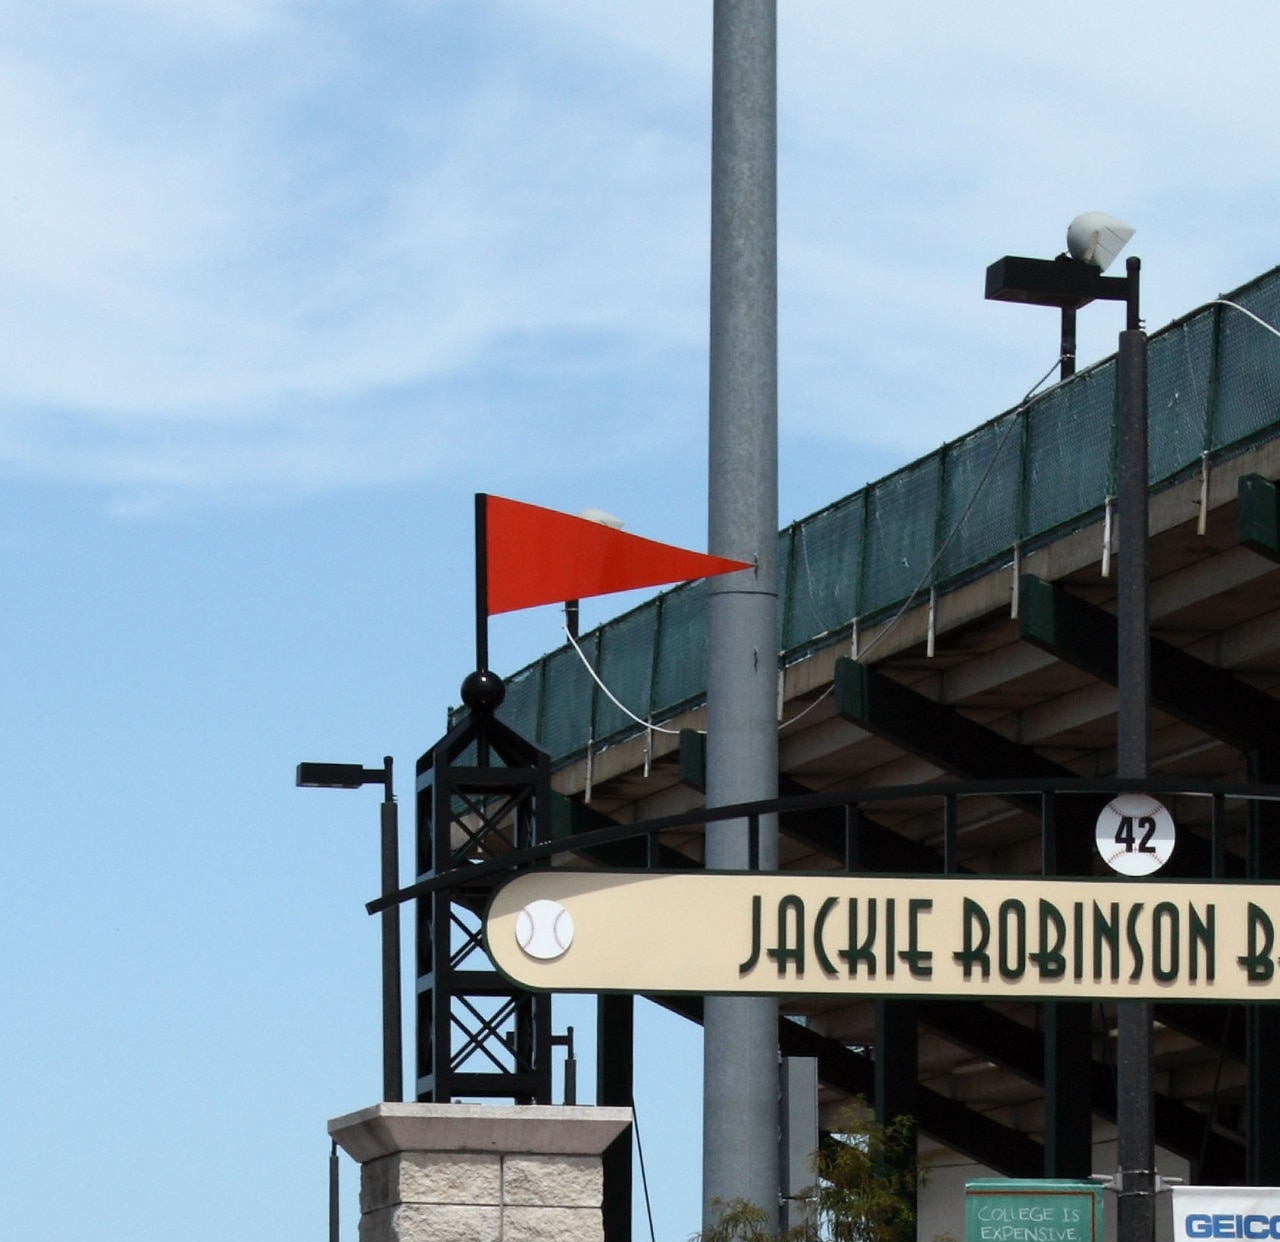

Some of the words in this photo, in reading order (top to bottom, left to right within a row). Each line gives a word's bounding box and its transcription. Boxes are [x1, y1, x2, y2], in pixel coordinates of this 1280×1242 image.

[1114, 816, 1157, 854] 42
[738, 894, 934, 977] JACKIE
[951, 897, 1216, 983] ROBINSON
[977, 1206, 1054, 1222] COLLEGE
[1062, 1207, 1080, 1222] IS
[981, 1226, 1082, 1242] EXPENSIVE,
